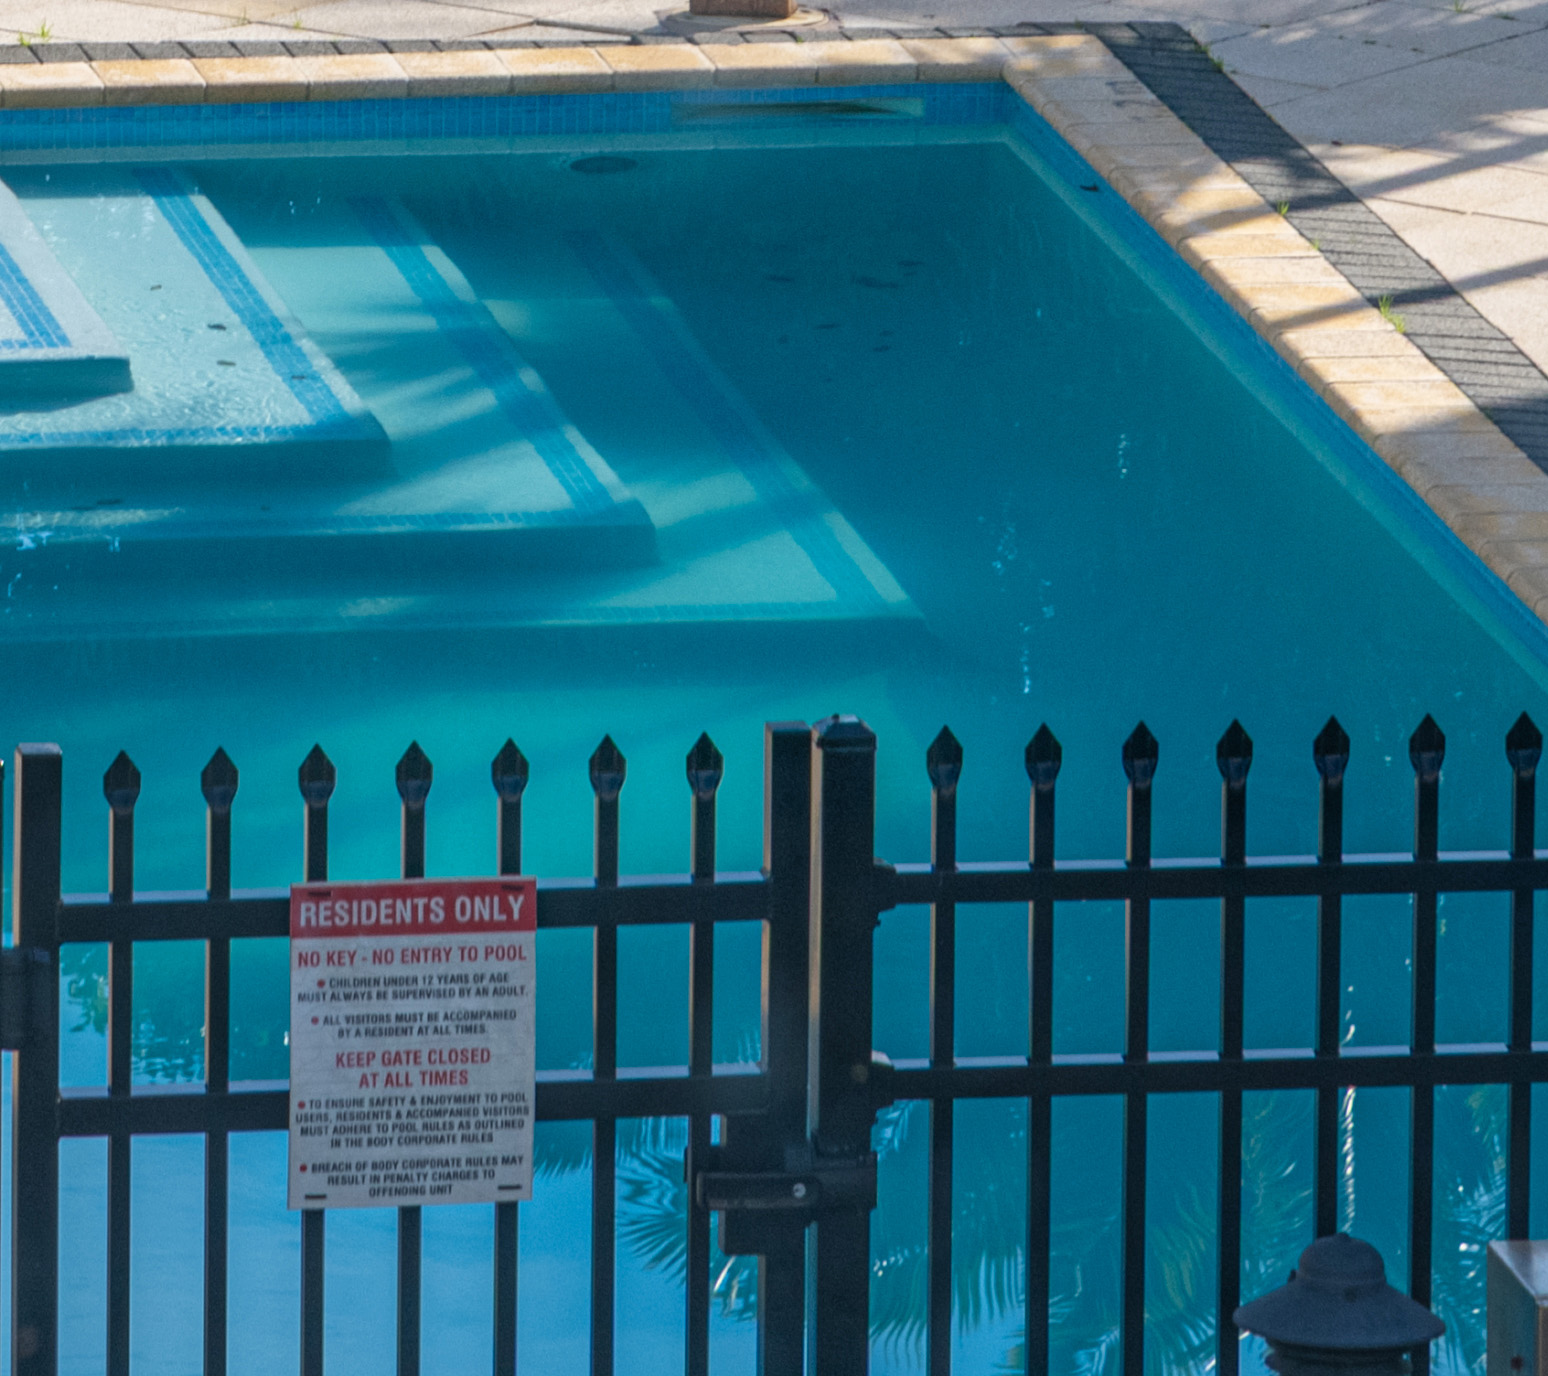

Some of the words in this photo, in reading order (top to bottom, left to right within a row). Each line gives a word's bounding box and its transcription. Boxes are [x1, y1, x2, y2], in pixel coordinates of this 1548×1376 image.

[299, 896, 445, 926] RESIDENTS
[454, 894, 525, 922] ONLY
[297, 951, 321, 968] NO
[326, 950, 357, 966] KEY
[372, 948, 394, 965] NO
[400, 946, 452, 964] ENTRY
[457, 946, 478, 962] TO
[484, 944, 527, 961] POOL
[336, 1051, 376, 1067] KEEP
[381, 1050, 422, 1067] GATE
[427, 1048, 491, 1065] CLOSED
[358, 1072, 379, 1088] AT
[383, 1071, 413, 1088] ALL
[419, 1069, 468, 1086] TIMES
